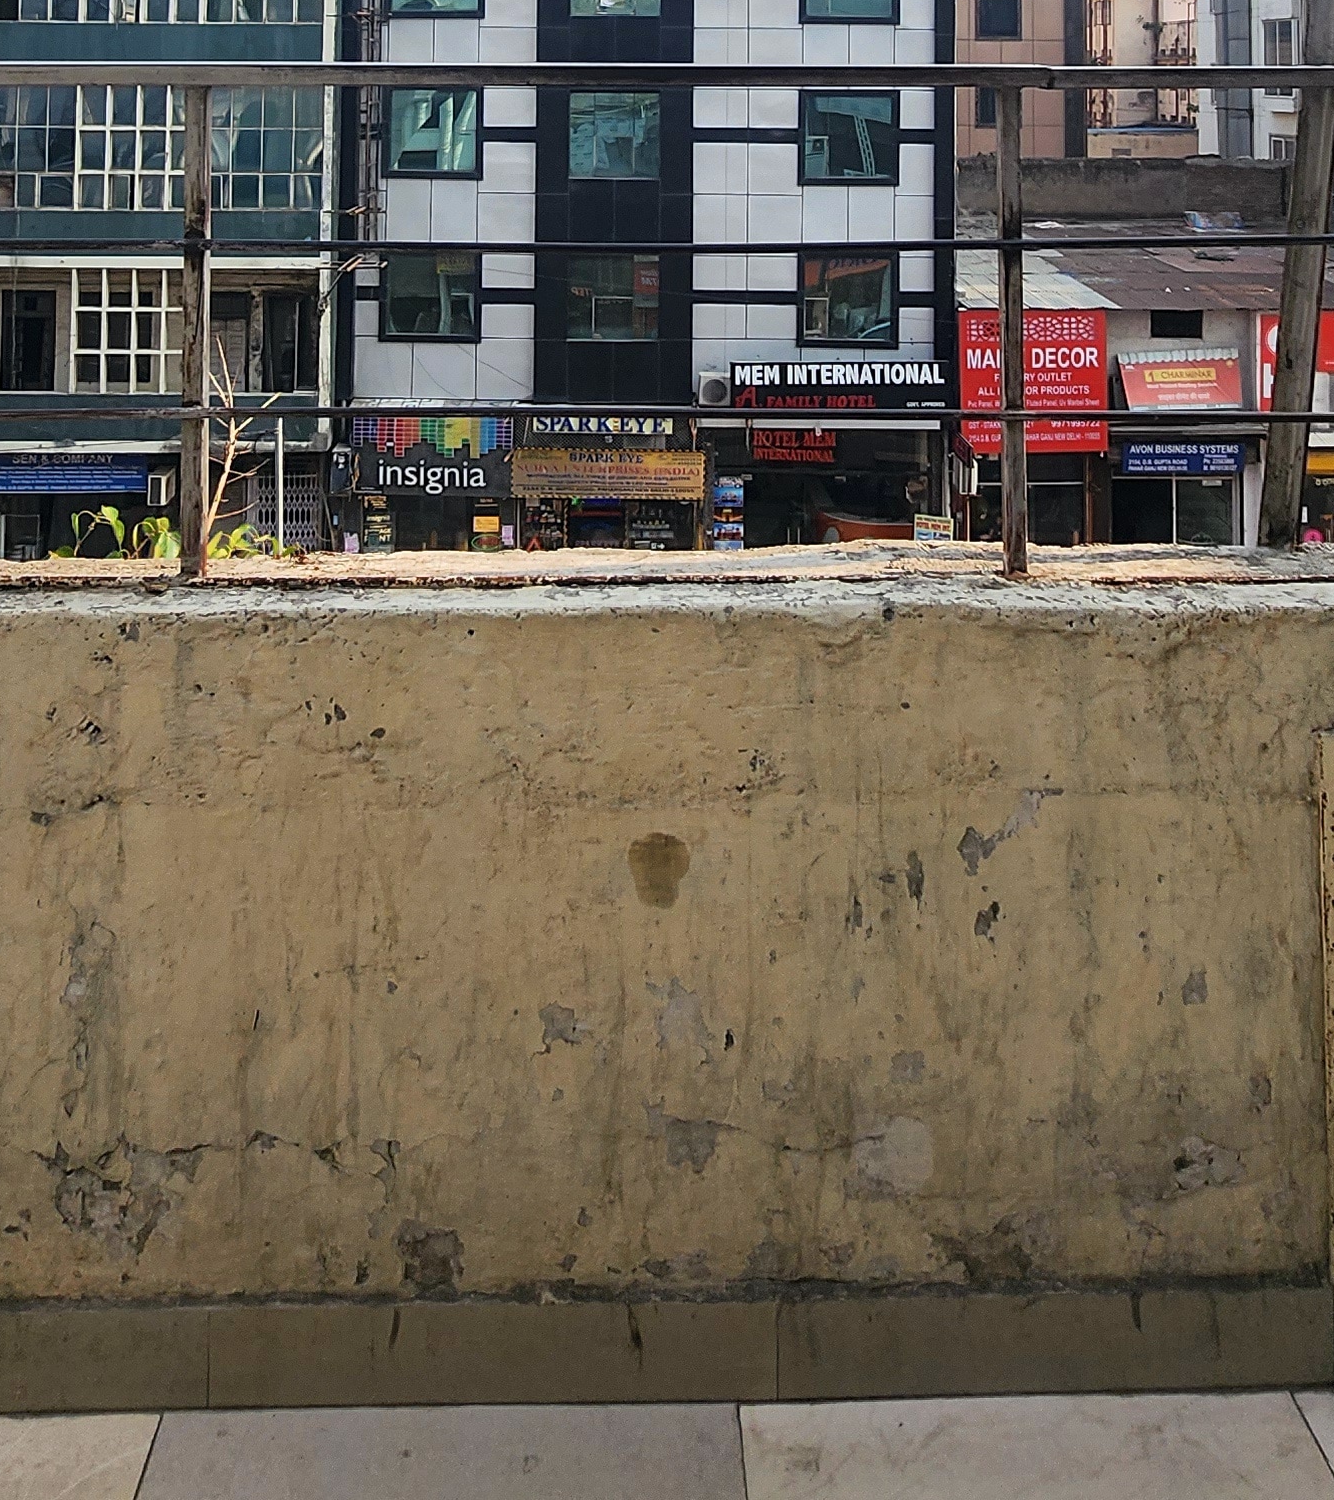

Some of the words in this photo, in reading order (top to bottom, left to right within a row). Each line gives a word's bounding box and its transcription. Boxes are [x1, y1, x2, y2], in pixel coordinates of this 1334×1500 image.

[1031, 347, 1099, 369] DECOR
[735, 365, 780, 386] MEM
[787, 364, 945, 385] INTERNATIONAL
[1037, 372, 1072, 382] OUTLET
[1161, 370, 1213, 380] CHARMINAR
[978, 387, 995, 396] ALL
[1040, 385, 1090, 395] PRODUCTS
[766, 396, 823, 408] FAMILY
[826, 395, 876, 408] HOTEL
[536, 417, 612, 432] SPARK
[621, 418, 667, 433] EYE
[753, 431, 796, 447] HOTEL
[803, 432, 836, 447] MEM
[1129, 445, 1153, 454] AVON
[1155, 445, 1198, 454] BUSINESS
[1199, 444, 1239, 454] SYSTEMS
[12, 454, 37, 464] SEN
[569, 452, 614, 463] SPARK
[618, 453, 644, 464] EYE
[754, 449, 835, 463] INTERNATIONAL
[563, 465, 650, 475] ENTERPRISES
[378, 459, 486, 494] insignia
